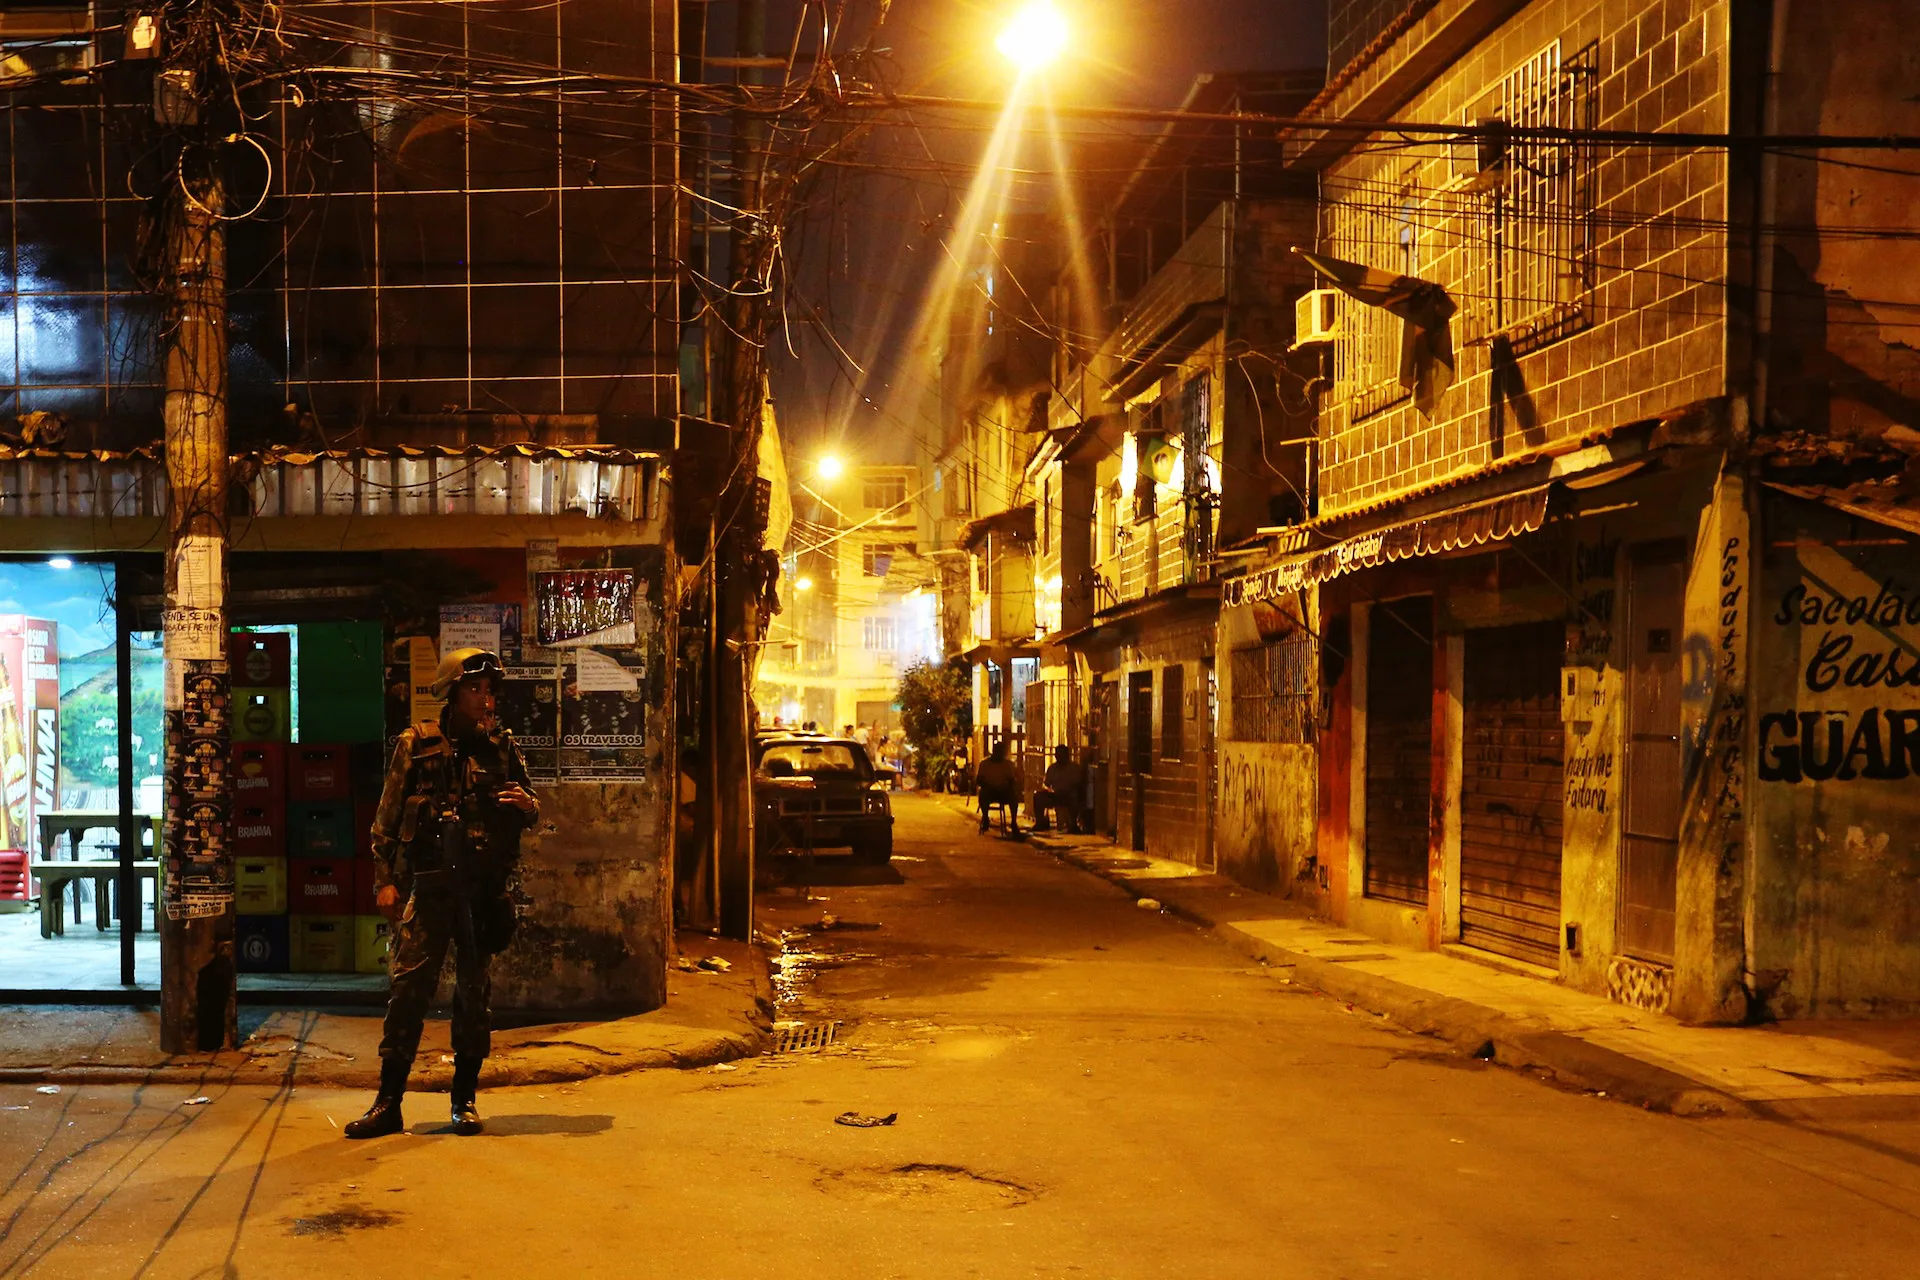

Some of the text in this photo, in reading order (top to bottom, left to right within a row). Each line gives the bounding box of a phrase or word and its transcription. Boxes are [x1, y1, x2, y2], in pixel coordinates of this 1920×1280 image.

[564, 735, 642, 745] OS TRAVESSOS
[237, 778, 269, 789] BRAHMA
[237, 826, 272, 837] BRAHMA
[304, 884, 338, 896] BRAHMA
